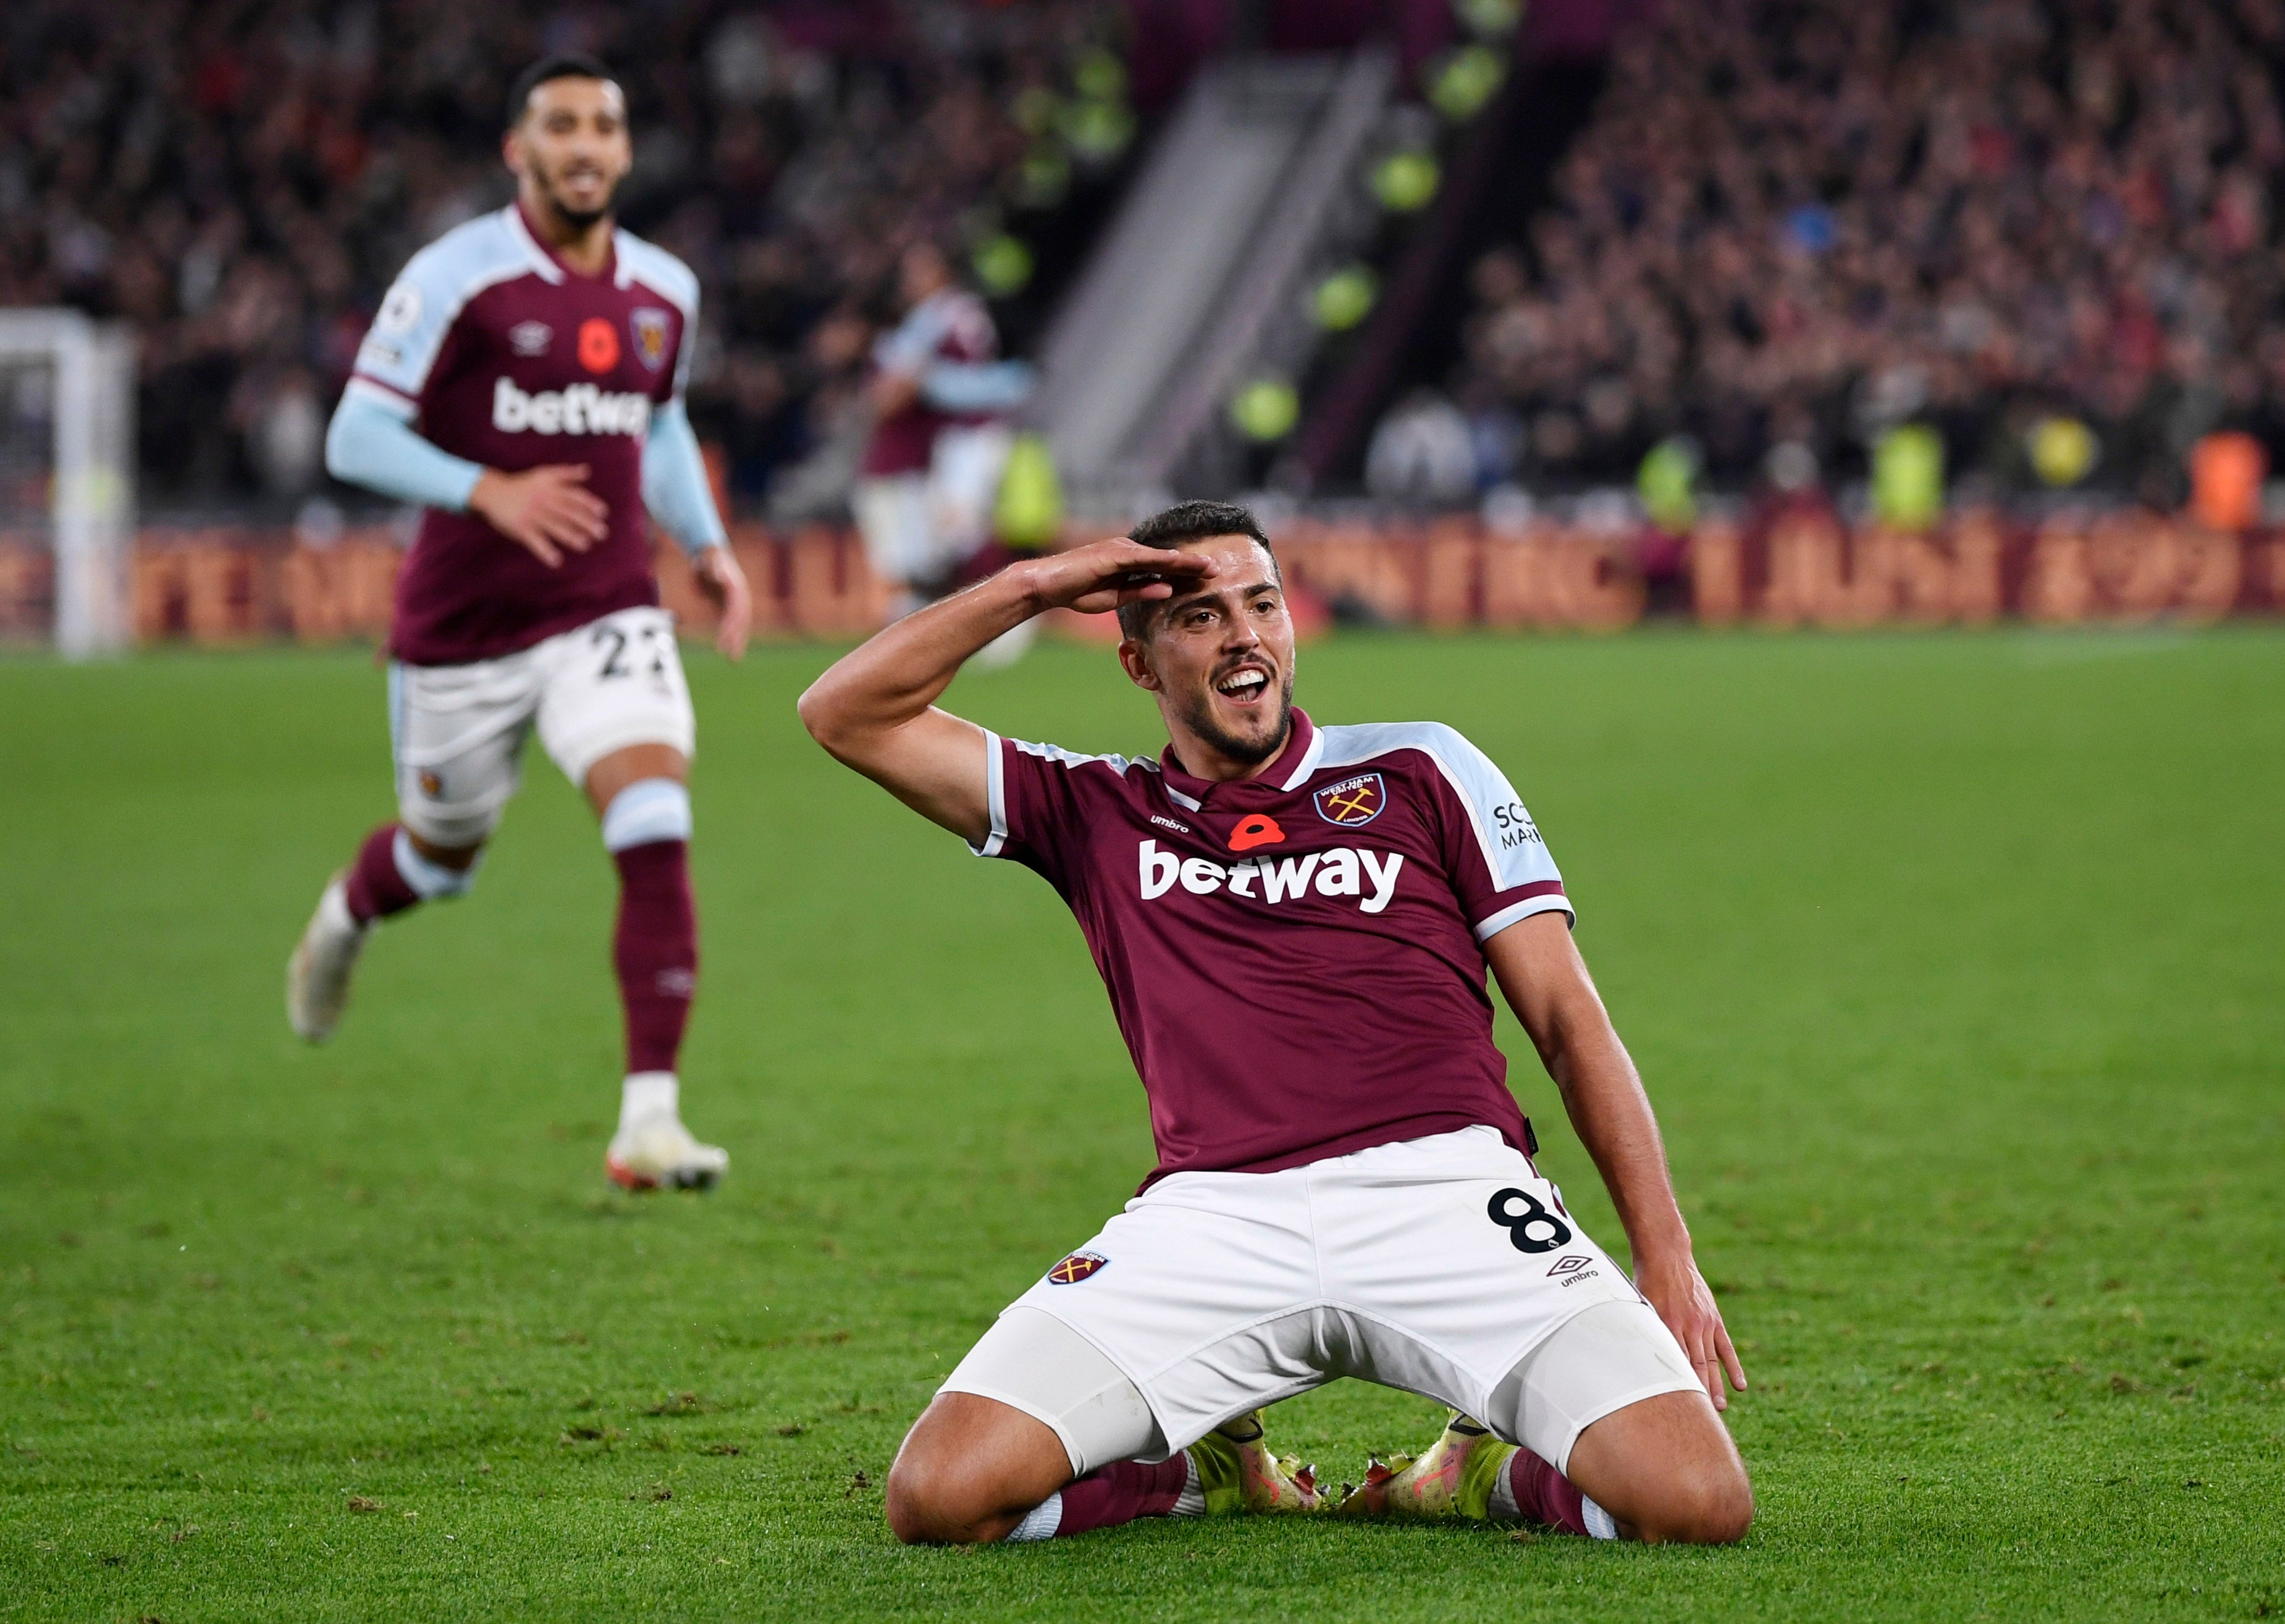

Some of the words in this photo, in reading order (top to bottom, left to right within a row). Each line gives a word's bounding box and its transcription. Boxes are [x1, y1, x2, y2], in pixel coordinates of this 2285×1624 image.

[1150, 815, 1189, 833] umbro
[1343, 815, 1368, 823] LONDON
[1138, 839, 1404, 914] betway
[1487, 1187, 1572, 1254] 8
[1560, 1269, 1599, 1287] umbro
